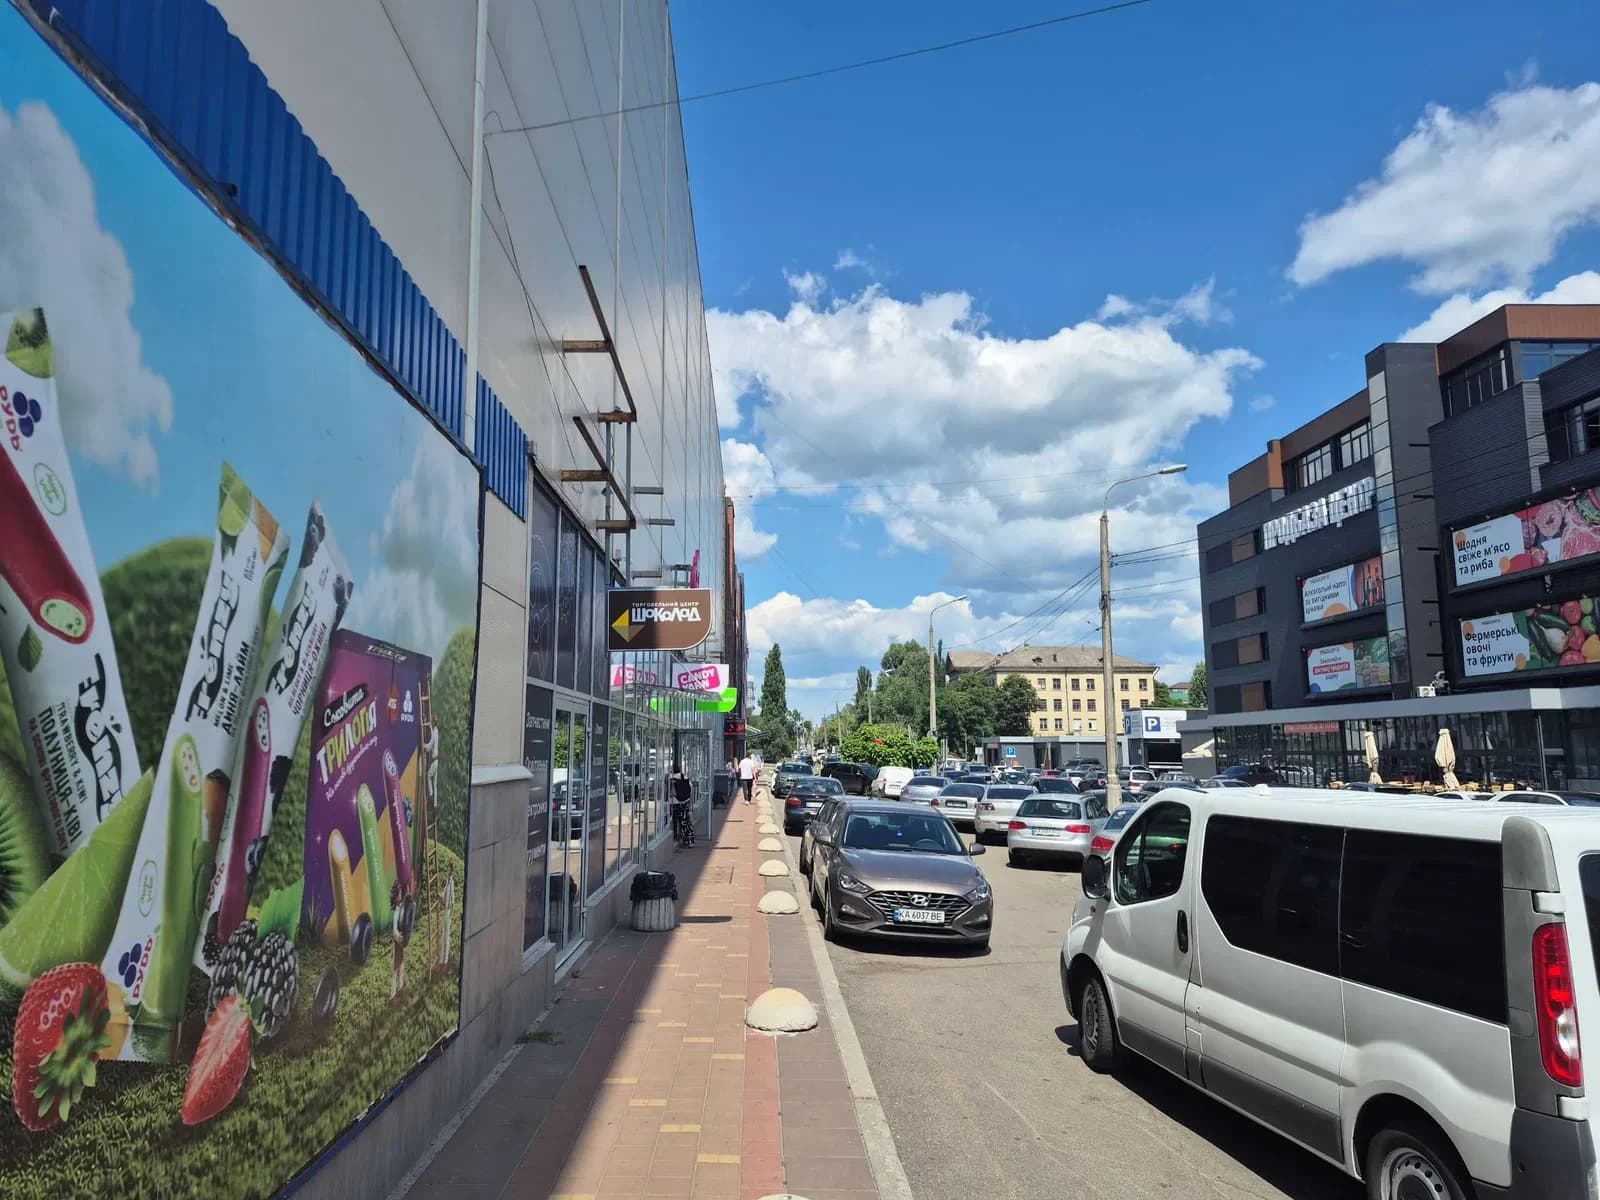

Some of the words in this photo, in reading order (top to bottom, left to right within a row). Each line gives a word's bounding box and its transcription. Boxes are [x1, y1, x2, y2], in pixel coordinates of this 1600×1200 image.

[1457, 536, 1487, 552] Щодня
[1458, 550, 1482, 564] свіже
[1459, 566, 1469, 575] та
[1470, 559, 1494, 576] риба
[1466, 641, 1491, 655] овочі
[1467, 657, 1478, 666] та
[1479, 653, 1514, 668] фрукти
[680, 668, 715, 684] CANDY
[221, 641, 251, 736] ДИНЯ-ЛАЙМ
[1147, 718, 1158, 731] P
[38, 706, 82, 844] ПОЛУНИЦЯ-КІВІ
[74, 777, 88, 804] KIWI
[899, 909, 910, 919] KA
[912, 910, 929, 920] 6037
[931, 911, 942, 921] BE
